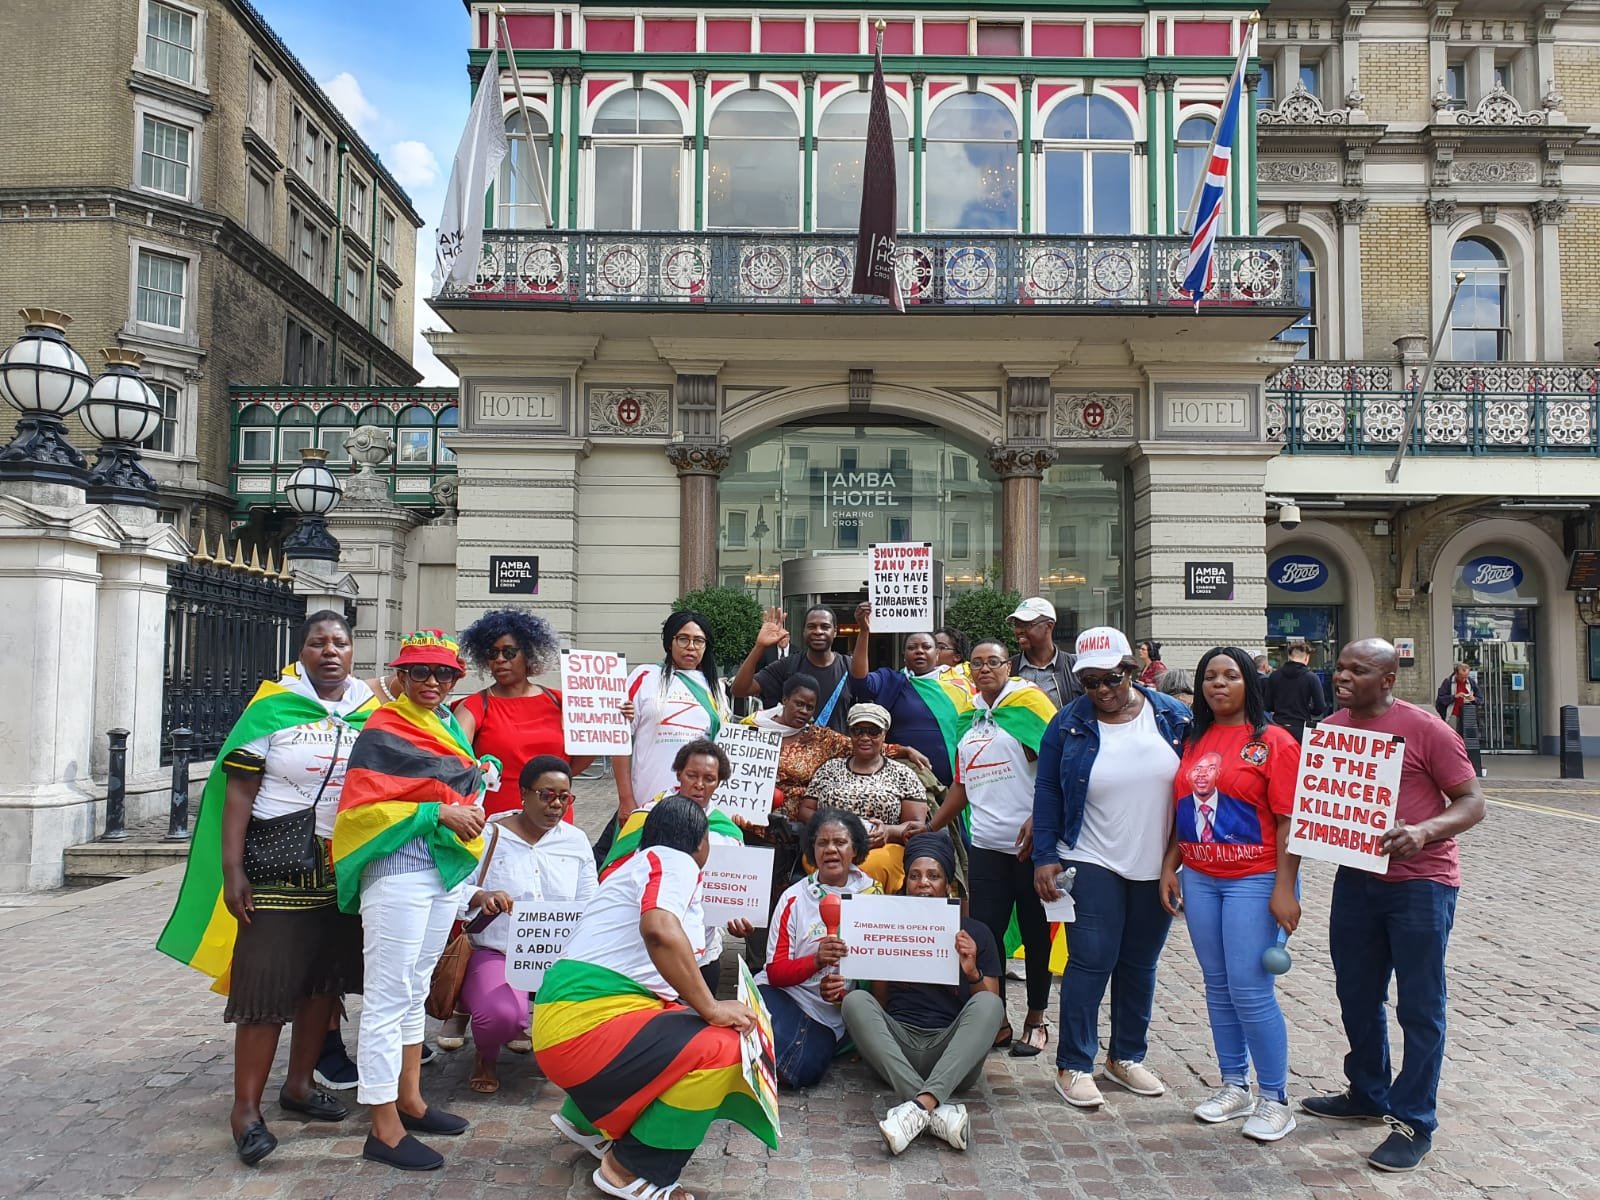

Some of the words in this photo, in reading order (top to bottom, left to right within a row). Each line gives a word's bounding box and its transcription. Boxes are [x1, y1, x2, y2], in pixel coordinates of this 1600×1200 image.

[482, 396, 553, 417] HOTEL
[1172, 402, 1242, 423] HOTEL
[832, 472, 896, 488] AMBA
[832, 490, 899, 506] HOTEL
[874, 547, 929, 558] SHUTDOWN
[500, 561, 531, 569] AMBA
[874, 560, 905, 571] ZANU
[911, 560, 929, 570] PF!
[1195, 567, 1226, 576] AMBA
[500, 569, 532, 578] HOTEL
[875, 573, 899, 582] THEY
[903, 572, 928, 582] HAVE
[1195, 576, 1228, 584] HOTEL
[1278, 562, 1320, 584] Boots
[1472, 563, 1514, 585] Boots
[875, 596, 928, 606] ZIMBABWE'S
[875, 608, 928, 618] ECONOMY!
[1078, 636, 1110, 655] CHAMISA
[568, 654, 618, 675] STOP
[567, 675, 627, 692] BRUTALITY
[567, 696, 594, 708] FREE
[599, 697, 622, 709] THE
[570, 729, 630, 744] DETAINED
[1309, 729, 1366, 754] ZANU
[1371, 739, 1397, 759] PF
[741, 763, 776, 779] SAME
[1306, 753, 1325, 768] IS
[1332, 757, 1377, 780] THE
[720, 778, 764, 795] ASTY
[1303, 774, 1392, 806] CANCER
[1300, 797, 1387, 830] KILLING
[747, 898, 759, 907] !!!
[517, 928, 551, 938] OPEN
[554, 928, 573, 938] FO
[864, 934, 935, 944] REPRESSION
[515, 944, 523, 953] &
[527, 944, 562, 953] ABDU
[937, 949, 948, 958] !!!
